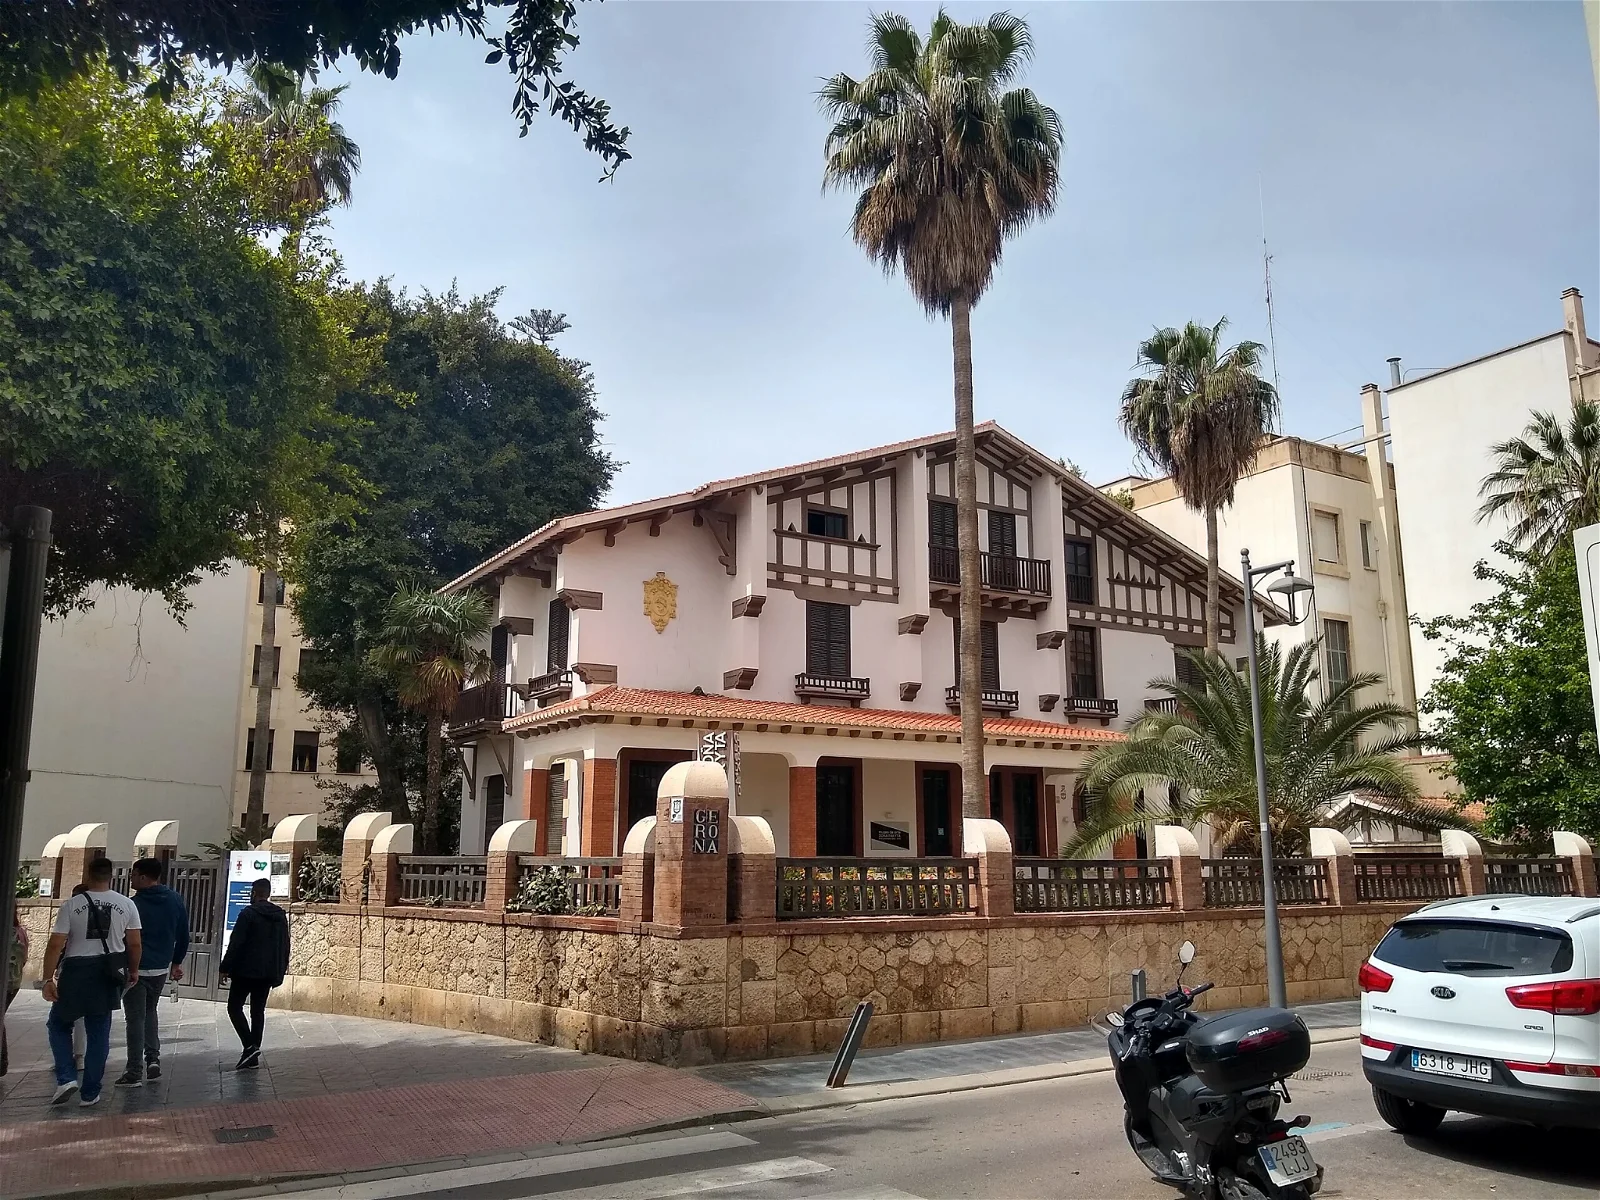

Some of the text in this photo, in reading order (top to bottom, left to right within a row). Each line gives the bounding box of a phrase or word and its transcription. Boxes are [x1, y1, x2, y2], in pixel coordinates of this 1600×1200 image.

[701, 731, 715, 762] OÑA
[1433, 987, 1452, 998] KIA
[1247, 1026, 1270, 1037] SHAD
[1420, 1053, 1455, 1070] 6318
[1461, 1060, 1488, 1075] JHG
[1271, 1139, 1306, 1162] 2493
[1282, 1156, 1310, 1177] LJJ
